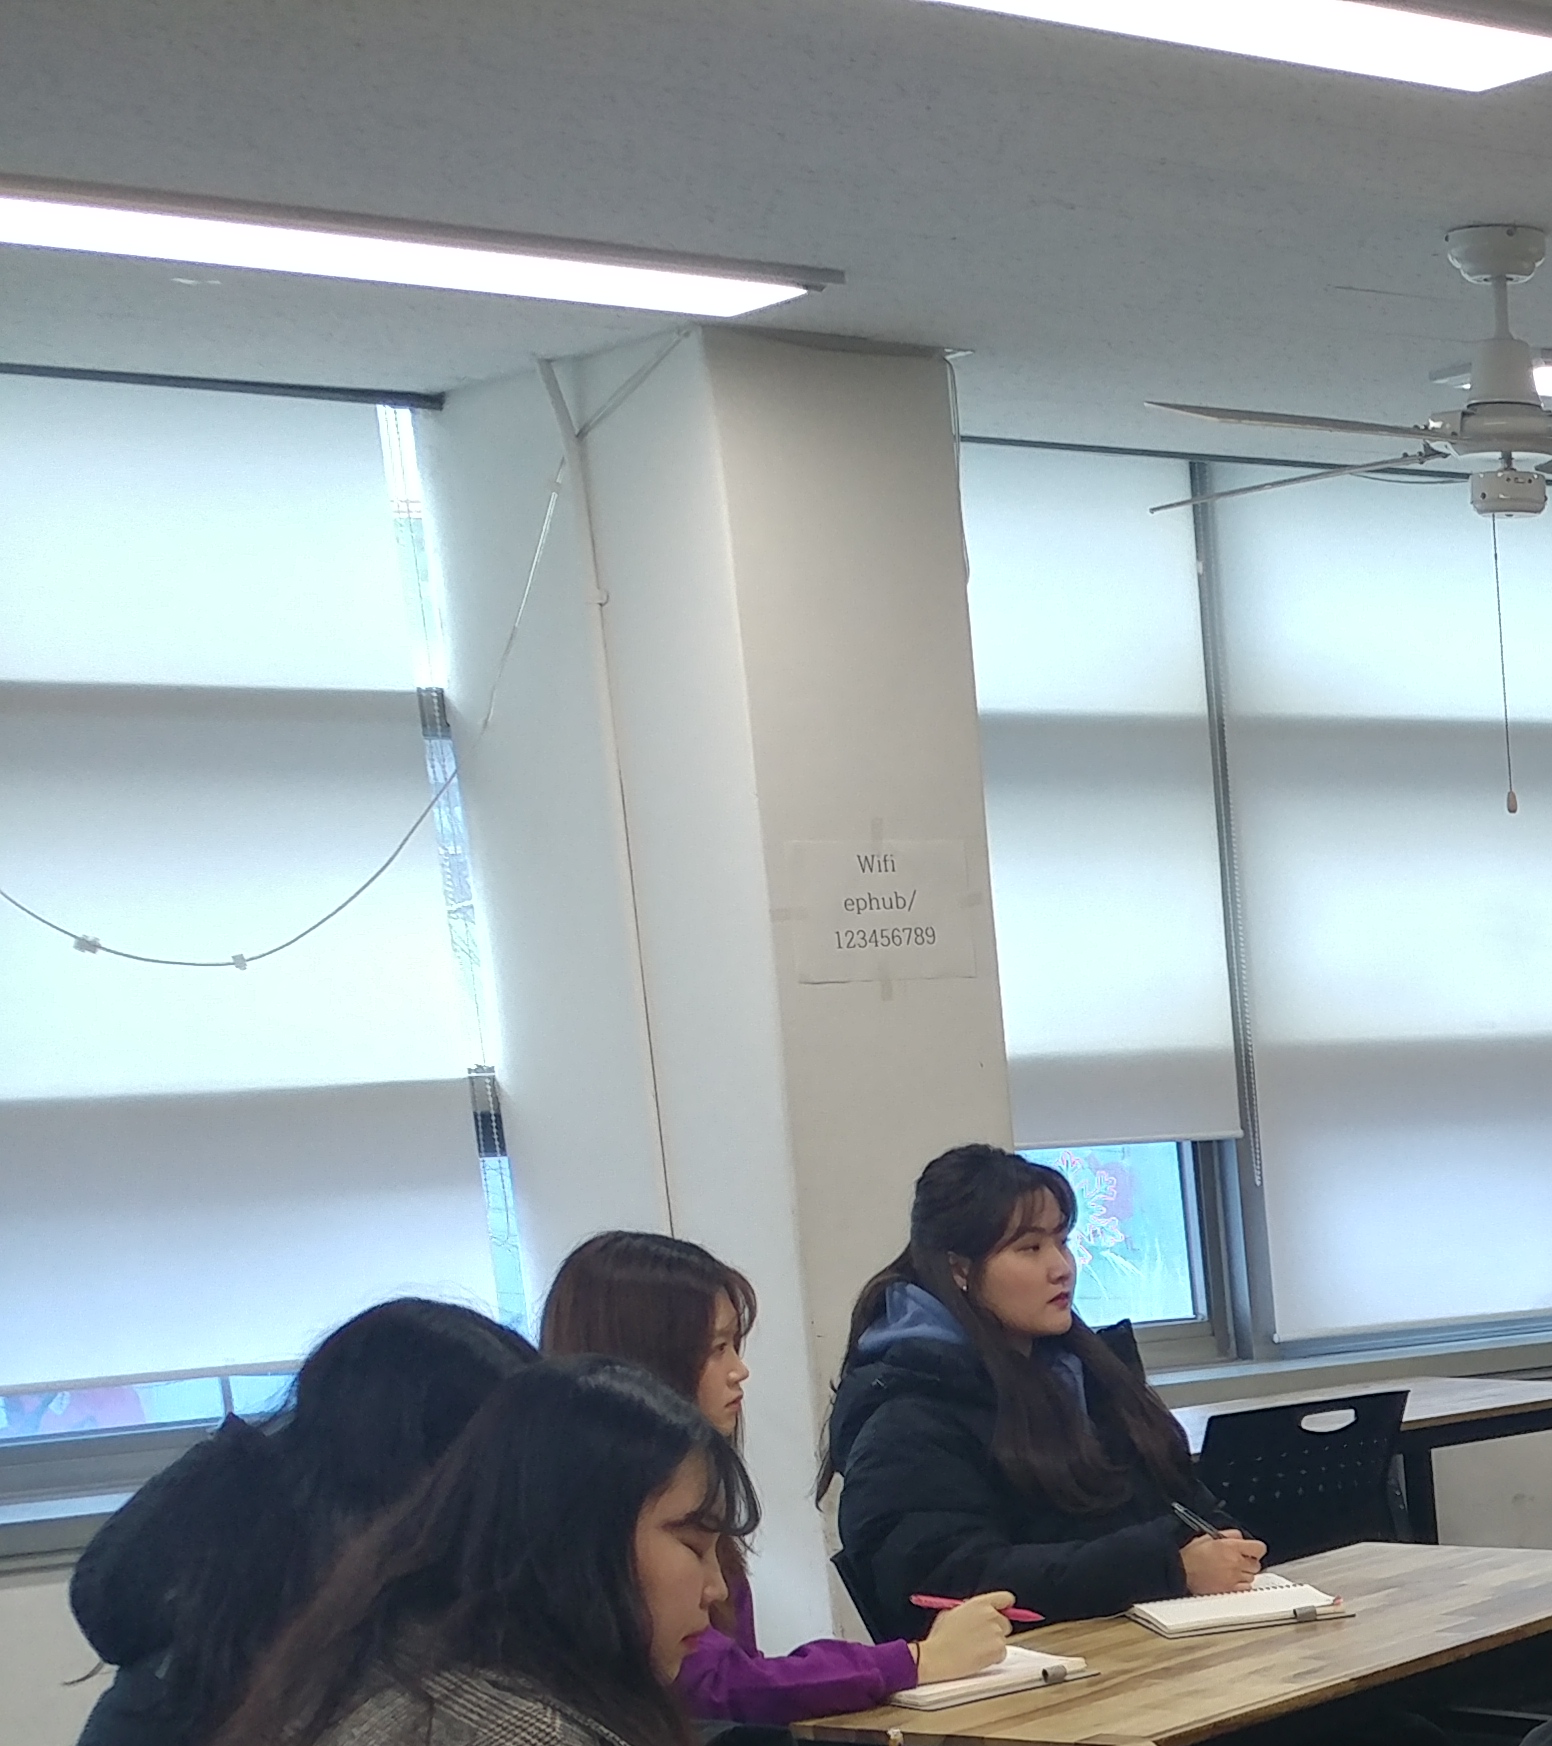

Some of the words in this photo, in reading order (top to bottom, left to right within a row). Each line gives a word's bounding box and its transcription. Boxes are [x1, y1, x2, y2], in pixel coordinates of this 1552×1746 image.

[856, 853, 897, 873] Wifi
[843, 889, 917, 915] ephub/
[834, 926, 937, 950] 123456789
